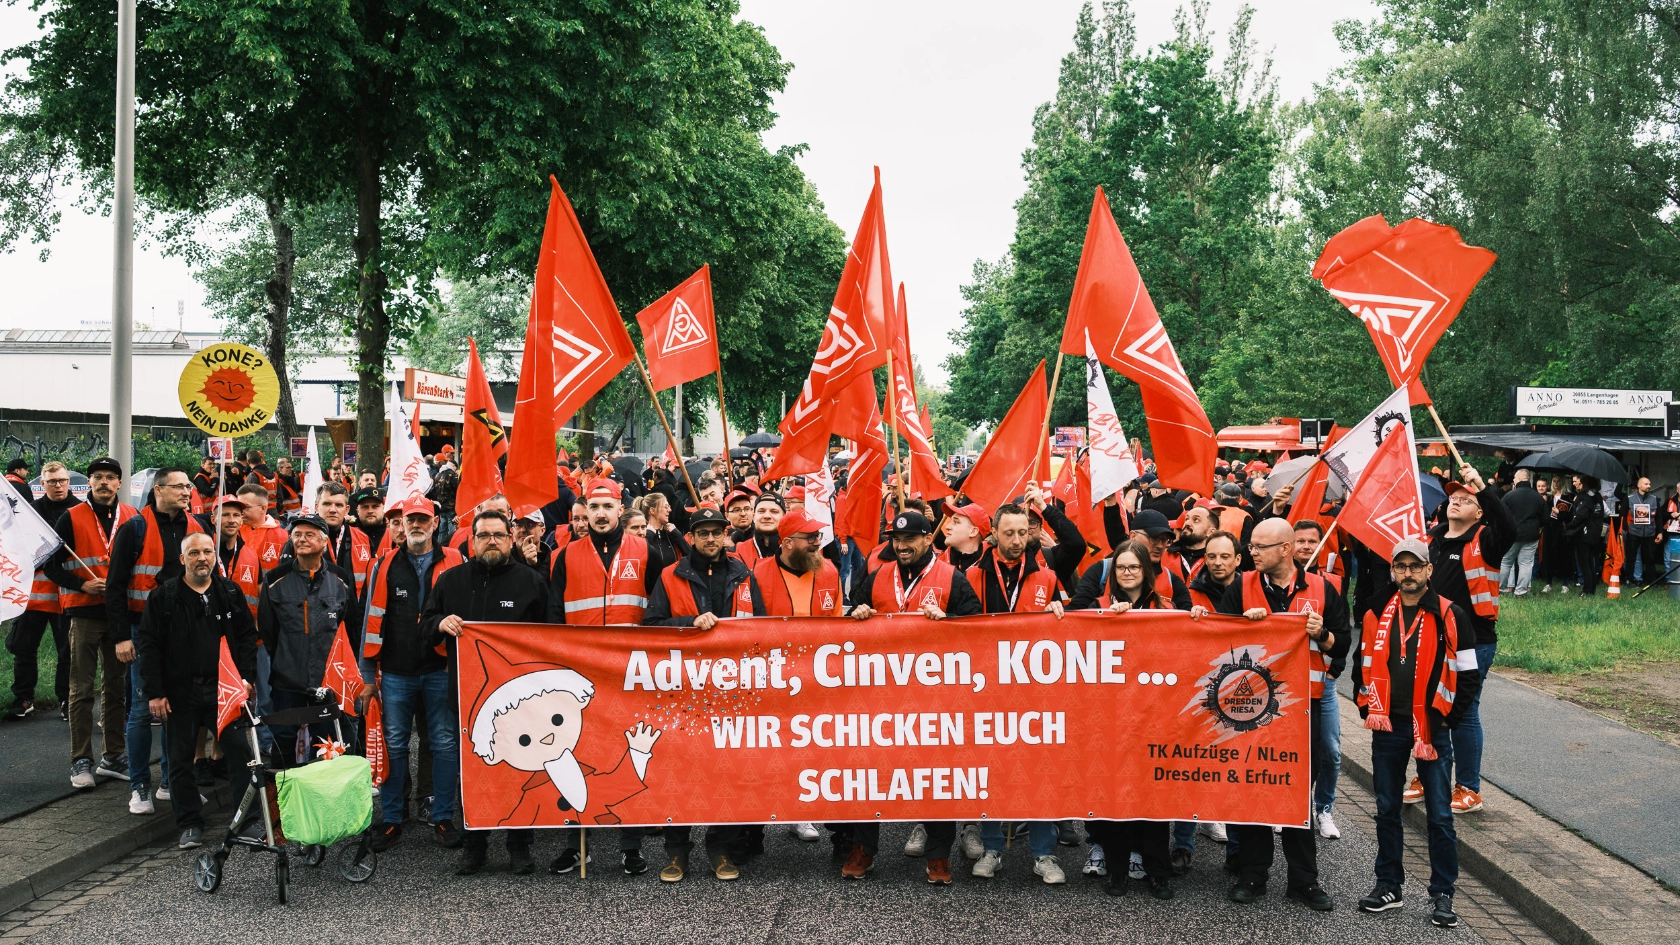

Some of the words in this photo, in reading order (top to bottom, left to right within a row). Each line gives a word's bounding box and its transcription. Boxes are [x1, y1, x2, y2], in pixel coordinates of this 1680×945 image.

[201, 348, 263, 371] KONE?
[1527, 393, 1563, 402] ANNO
[1629, 395, 1663, 404] ANNO
[186, 400, 217, 430] NEIN
[219, 409, 267, 434] DANKE
[622, 648, 803, 697] Advent,
[812, 640, 987, 693] Cinven,
[997, 639, 1126, 684] KONE
[1224, 698, 1263, 706] DRESDEN
[1230, 706, 1255, 714] RIESA
[710, 715, 783, 749] WIR
[789, 712, 965, 748] SCHICKEN
[974, 711, 1066, 745] EUCH
[1148, 744, 1168, 759] TK
[1171, 744, 1240, 763] Aufzüge
[1244, 745, 1252, 764] /
[1257, 747, 1299, 763] NLen
[797, 766, 990, 803] SCHLAFEN!
[1154, 767, 1221, 783] Dresden
[1226, 769, 1240, 784] &
[1245, 769, 1292, 786] Erfurt
